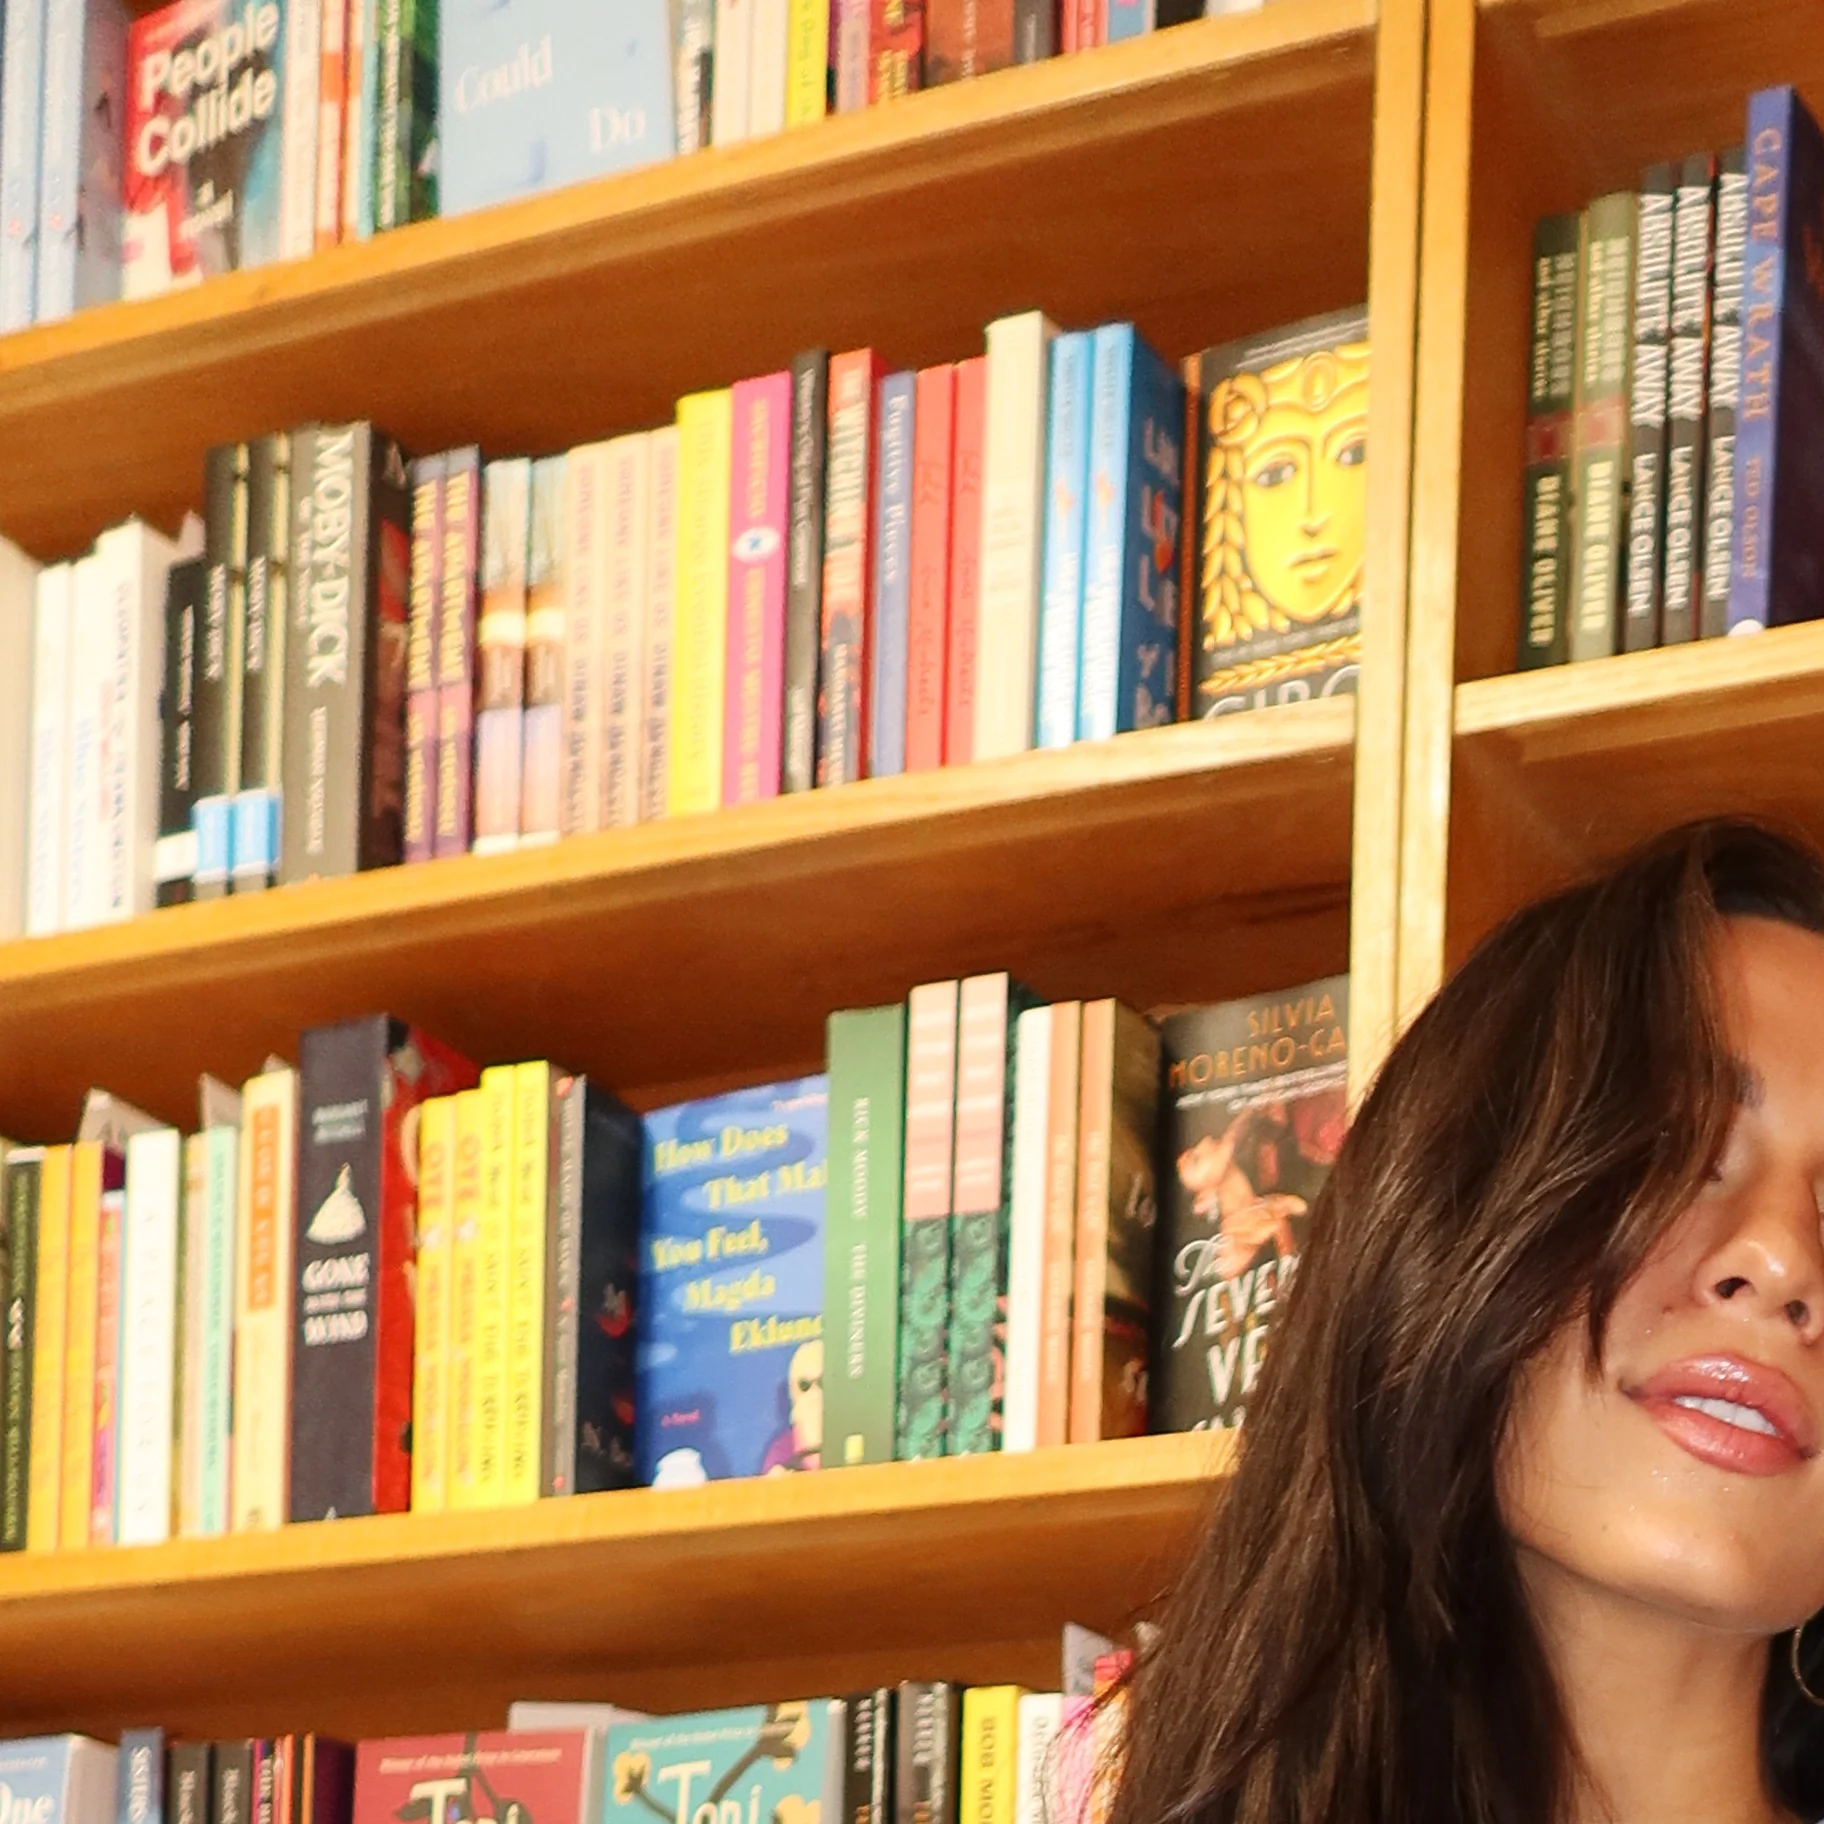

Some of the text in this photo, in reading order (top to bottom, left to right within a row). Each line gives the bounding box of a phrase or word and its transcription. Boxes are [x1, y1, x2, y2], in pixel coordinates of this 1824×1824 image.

[454, 36, 553, 117] Could
[136, 66, 277, 178] Collide
[587, 107, 645, 155] Do
[1748, 127, 1783, 243] CAPE
[1709, 324, 1743, 409] AWAY
[1742, 255, 1777, 422] WRATH
[1710, 434, 1736, 514] LANCE
[1744, 456, 1763, 496] TED
[307, 429, 355, 690] MOBY-DICK
[1581, 461, 1614, 631] DIANE OLIVER
[1706, 517, 1734, 601] OLSEN
[1246, 993, 1336, 1038] SILVIA
[652, 1120, 790, 1174] How Does
[704, 1169, 773, 1211] That
[652, 1219, 769, 1272] You Feel,
[847, 1097, 870, 1379] RICK MOODY THE DIVINERS
[682, 1270, 776, 1311] Magda
[980, 1716, 997, 1769] BOB
